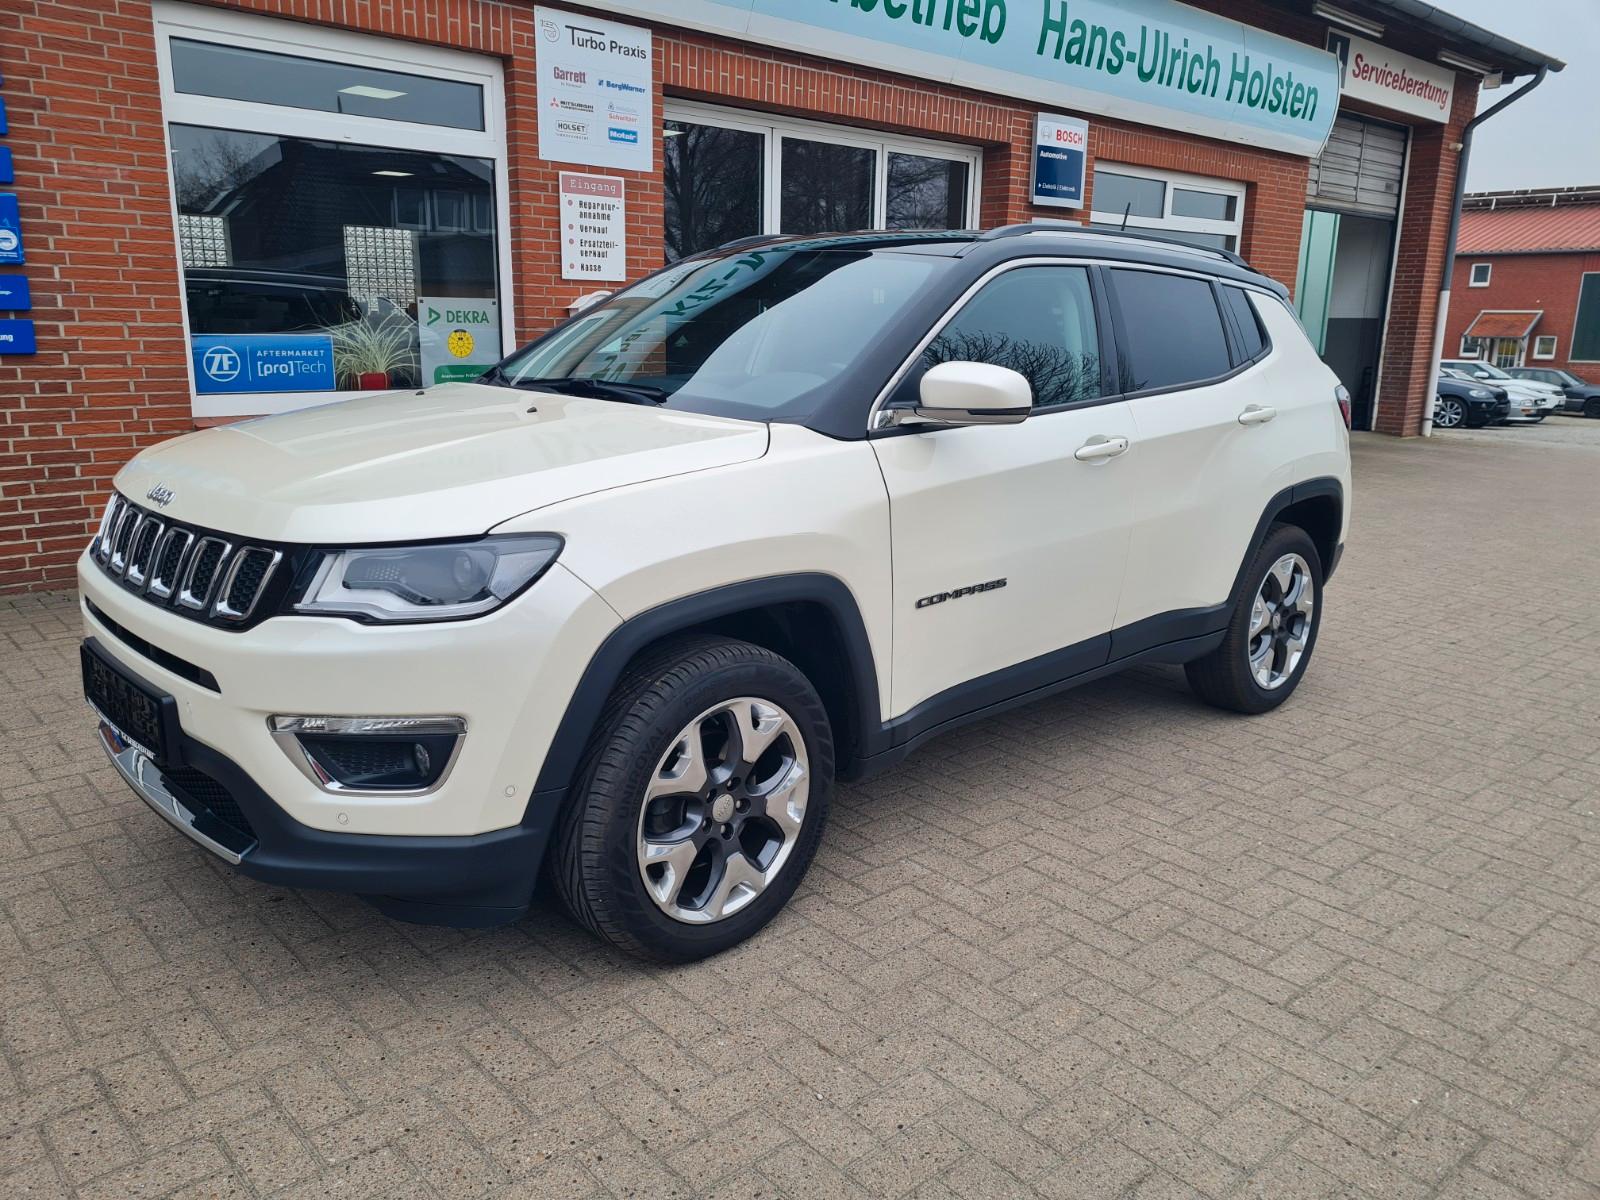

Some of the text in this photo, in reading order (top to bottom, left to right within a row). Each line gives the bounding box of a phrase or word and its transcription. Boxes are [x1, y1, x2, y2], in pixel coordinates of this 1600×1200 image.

[565, 24, 647, 60] Turbo Praxis
[1036, 0, 1221, 98] Hans-Ulrich
[1225, 52, 1319, 122] Holsten
[553, 66, 587, 84] Garrett
[1352, 52, 1450, 111] Serviceberatung
[557, 122, 586, 132] HOLSET
[609, 130, 637, 141] Motair
[1056, 129, 1083, 145] BOSCH
[1039, 150, 1068, 161] Automotive
[569, 179, 616, 194] Eingang
[578, 200, 620, 212] Reparatur-
[579, 211, 611, 221] annahme
[579, 224, 608, 235] Verkauf
[579, 238, 620, 249] Ersatzteil-
[580, 262, 602, 272] Kasse
[445, 310, 490, 324] DEKRA
[208, 353, 239, 375] ZF
[257, 360, 327, 377] [pro]Tech
[146, 482, 175, 509] Jeep
[914, 577, 1008, 609] COMPASS
